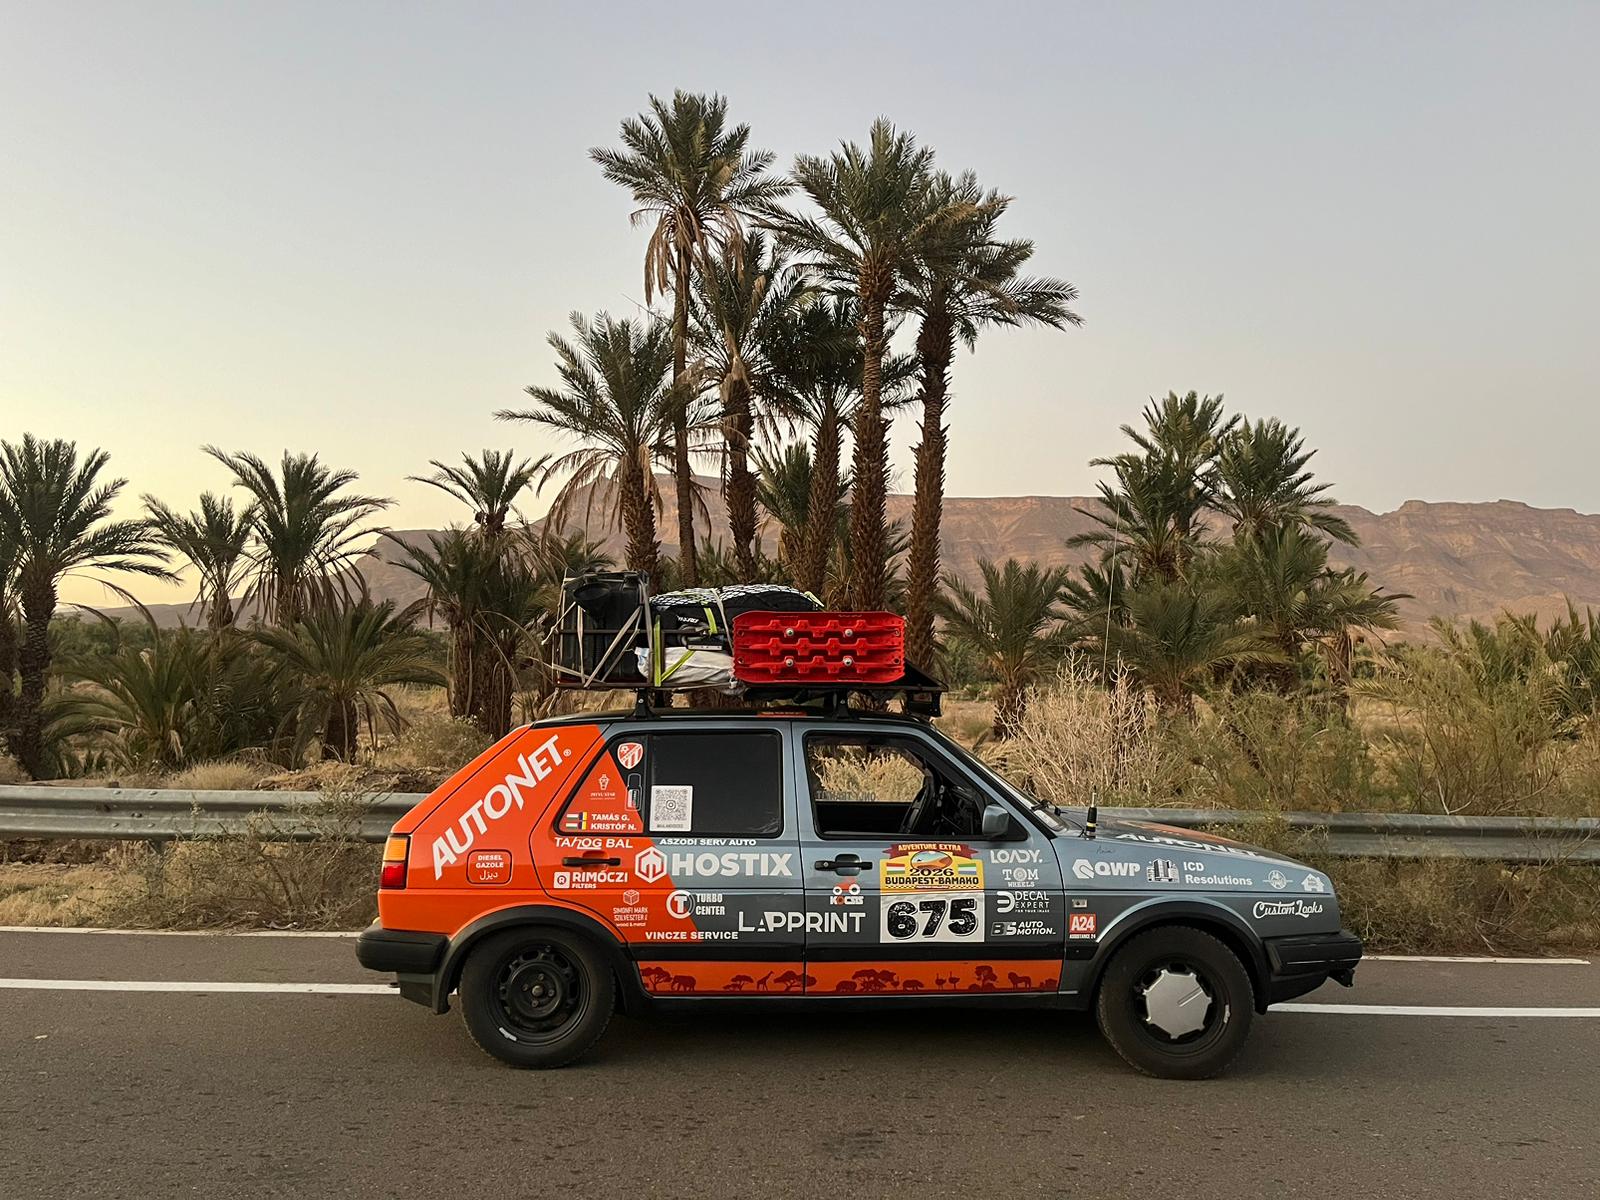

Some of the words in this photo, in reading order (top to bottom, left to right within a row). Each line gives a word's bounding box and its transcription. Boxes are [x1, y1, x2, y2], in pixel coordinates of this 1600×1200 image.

[591, 812, 620, 821] TAMÁS
[590, 821, 627, 830] KRISTÓF
[627, 823, 637, 831] N.
[605, 838, 634, 849] BAL
[898, 843, 937, 851] ADVENTURE
[939, 843, 961, 852] EXTRA
[475, 861, 504, 869] GAZOLE
[671, 852, 793, 877] HOSTIX
[1094, 861, 1141, 877] QWP
[1183, 861, 1205, 872] ICD
[479, 870, 499, 881] ديزل
[572, 869, 629, 883] RIMÓCZI
[909, 868, 955, 876] 2026
[885, 876, 979, 885] BUDAPEST-BAMAKO
[1185, 874, 1253, 886] Resolutions
[695, 893, 723, 903] TURBO
[1014, 890, 1050, 901] DECAL
[695, 905, 726, 916] CENTER
[1014, 901, 1050, 909] EXPERT
[1252, 901, 1295, 919] Custom
[1295, 899, 1324, 919] Looks
[887, 898, 979, 940] 675
[1018, 920, 1044, 928] AUTO
[1071, 916, 1096, 931] A24
[645, 931, 688, 940] VINCZE
[690, 931, 739, 940] SERVICE
